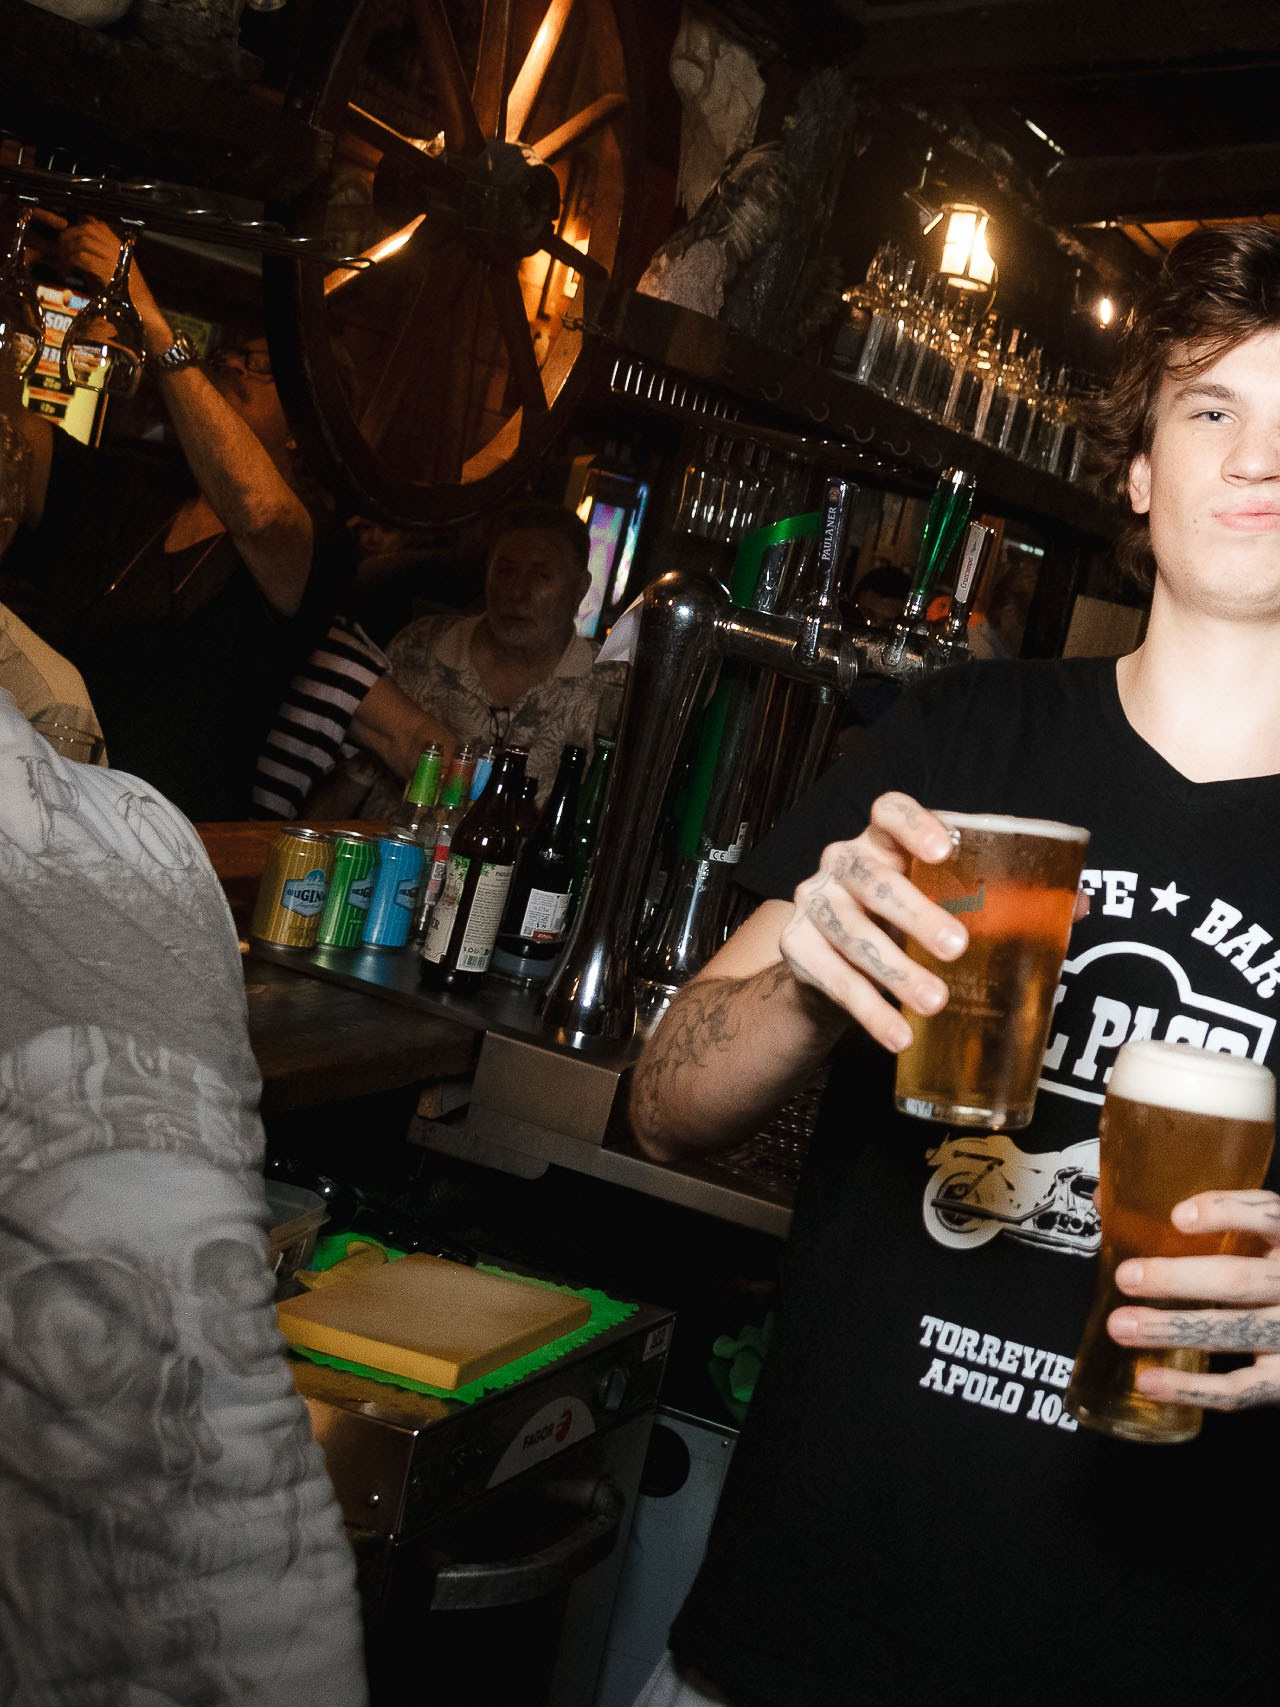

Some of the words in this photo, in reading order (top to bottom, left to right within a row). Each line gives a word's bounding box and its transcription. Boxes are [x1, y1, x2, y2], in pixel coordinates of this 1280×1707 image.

[821, 506, 837, 561] PAULANER
[919, 1315, 1076, 1389] TORREVIE
[919, 1358, 1025, 1413] APOLO
